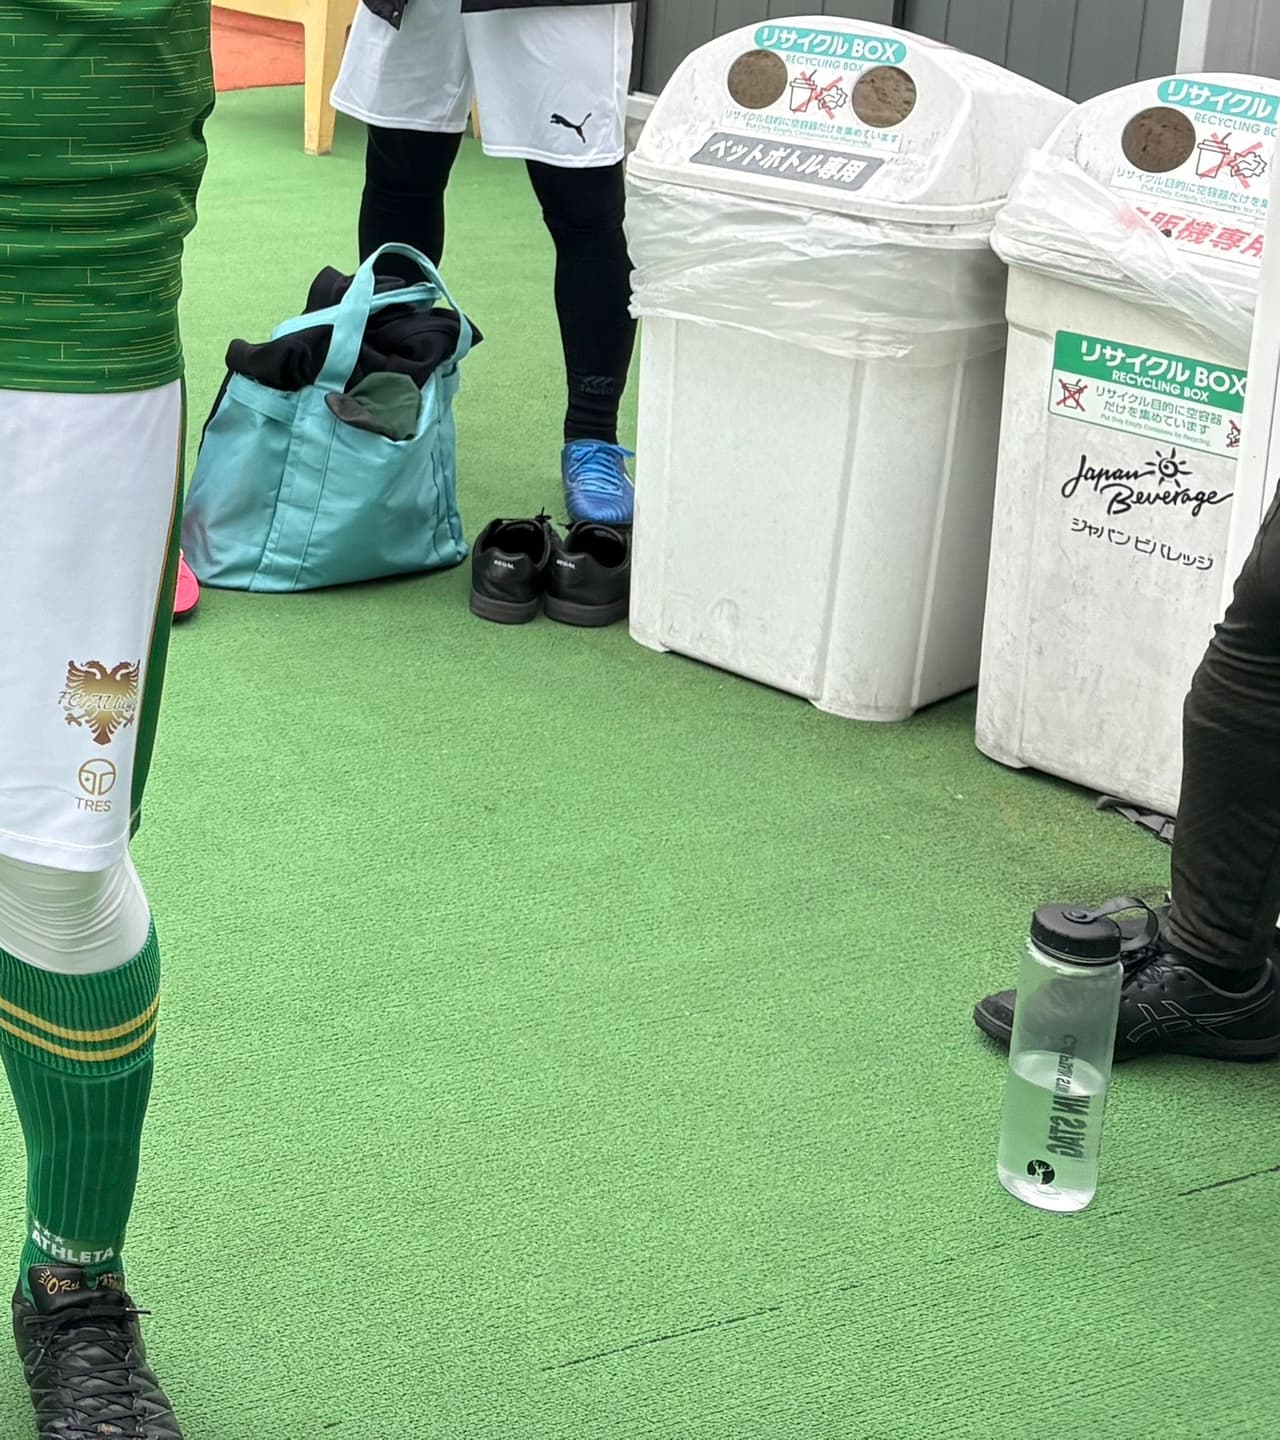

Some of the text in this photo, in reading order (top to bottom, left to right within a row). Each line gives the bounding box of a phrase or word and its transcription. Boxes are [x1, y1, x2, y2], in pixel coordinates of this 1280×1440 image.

[762, 27, 900, 63] リサイクル BOX
[784, 55, 865, 72] RECYCLING BOX
[1167, 80, 1273, 119] リサイクル
[1194, 112, 1262, 134] RECYCLING
[708, 139, 868, 184] ペットボトル専用
[1081, 340, 1248, 397] リサイクル BOX
[1111, 369, 1209, 402] RECYCLING BOX
[1095, 384, 1223, 427] リサイクル目的に空容器
[1103, 400, 1211, 436] だけを集めています
[1061, 454, 1155, 498] Japan
[1099, 482, 1234, 517] Beverage
[1071, 517, 1214, 571] ジャパン ビバレッジ
[75, 796, 112, 813] TRES
[31, 1227, 114, 1264] ATHLETA
